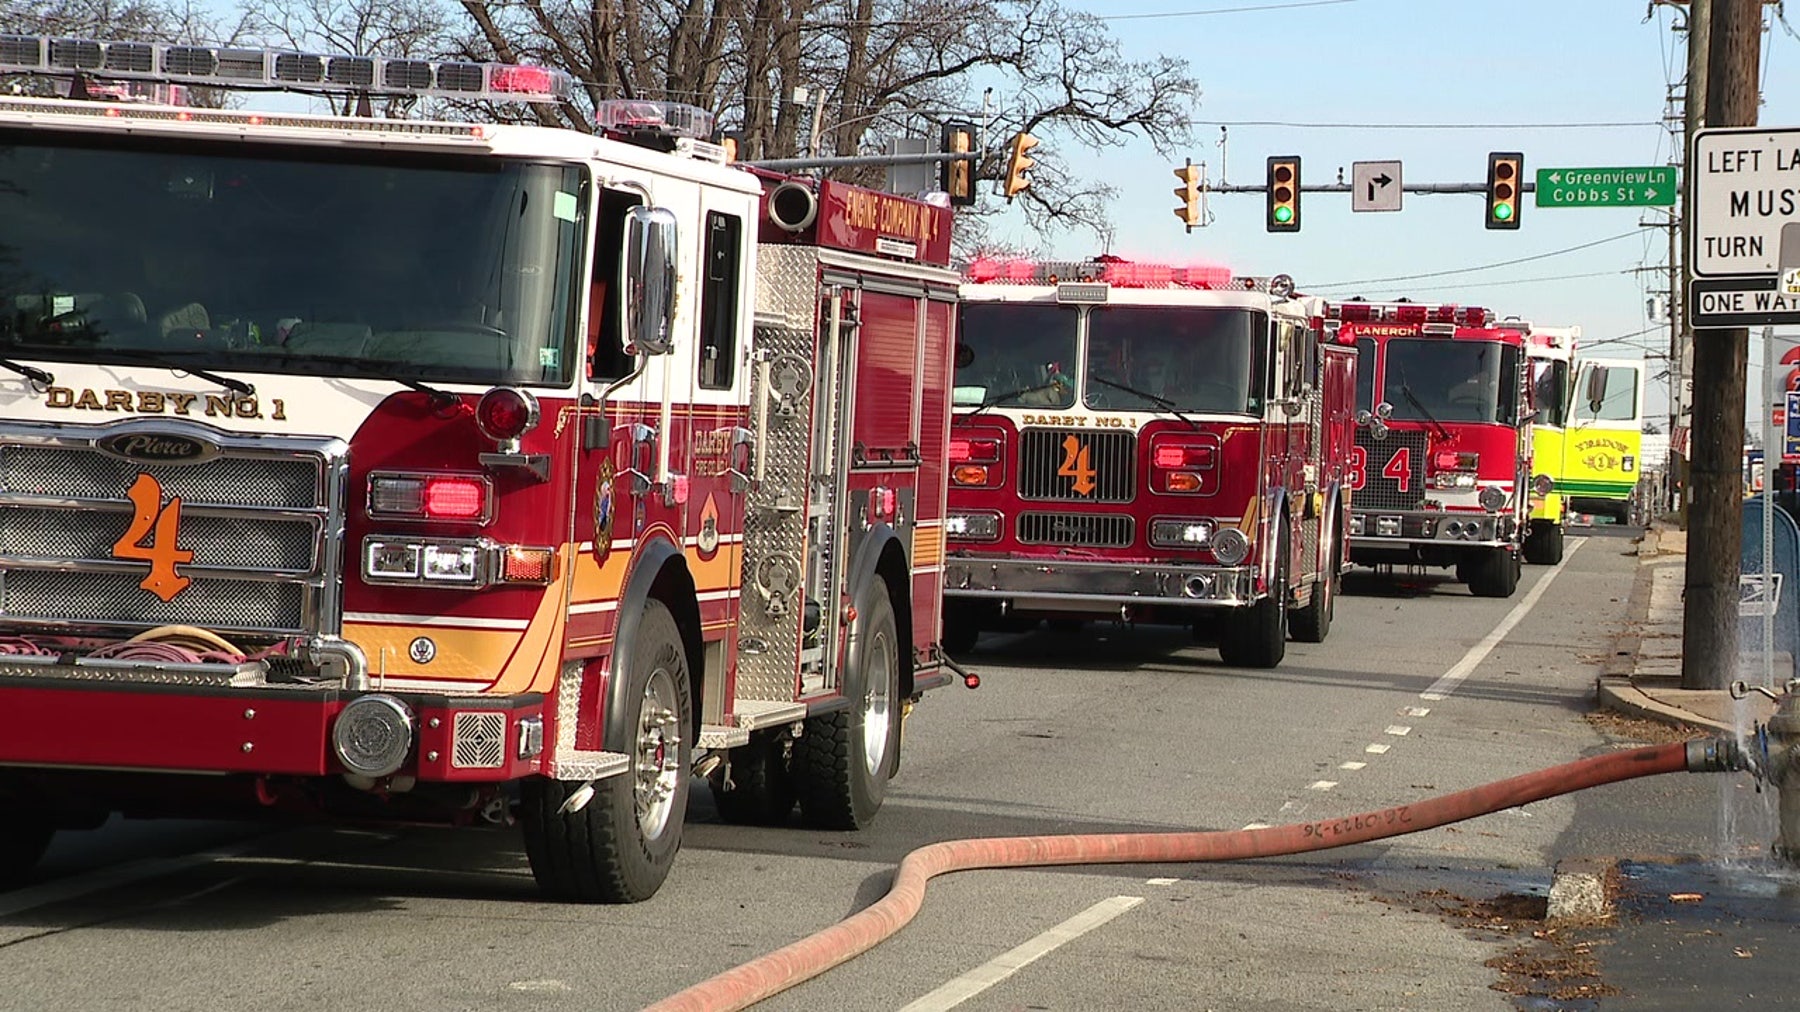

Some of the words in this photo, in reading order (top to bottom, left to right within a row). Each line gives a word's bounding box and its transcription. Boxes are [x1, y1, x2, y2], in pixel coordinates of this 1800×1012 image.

[1708, 150, 1762, 173] LEFT
[1565, 170, 1646, 185] Greenview
[1648, 170, 1666, 184] Ln
[1553, 188, 1609, 202] Cobbs
[1617, 187, 1635, 201] St
[1730, 189, 1800, 217] MUS
[846, 189, 878, 231] ENGINE
[881, 197, 918, 238] COMPANY
[1704, 236, 1763, 258] TURN
[1702, 293, 1744, 312] ONE
[45, 387, 198, 415] DARBY
[204, 394, 263, 419] NO.
[271, 399, 286, 420] 1
[1022, 414, 1087, 426] DARBY
[1095, 416, 1125, 428] NO.
[1129, 418, 1137, 428] 1
[124, 436, 192, 460] Pierce
[695, 430, 731, 455] DARBY
[1058, 435, 1096, 496] 4
[112, 472, 194, 603] 4
